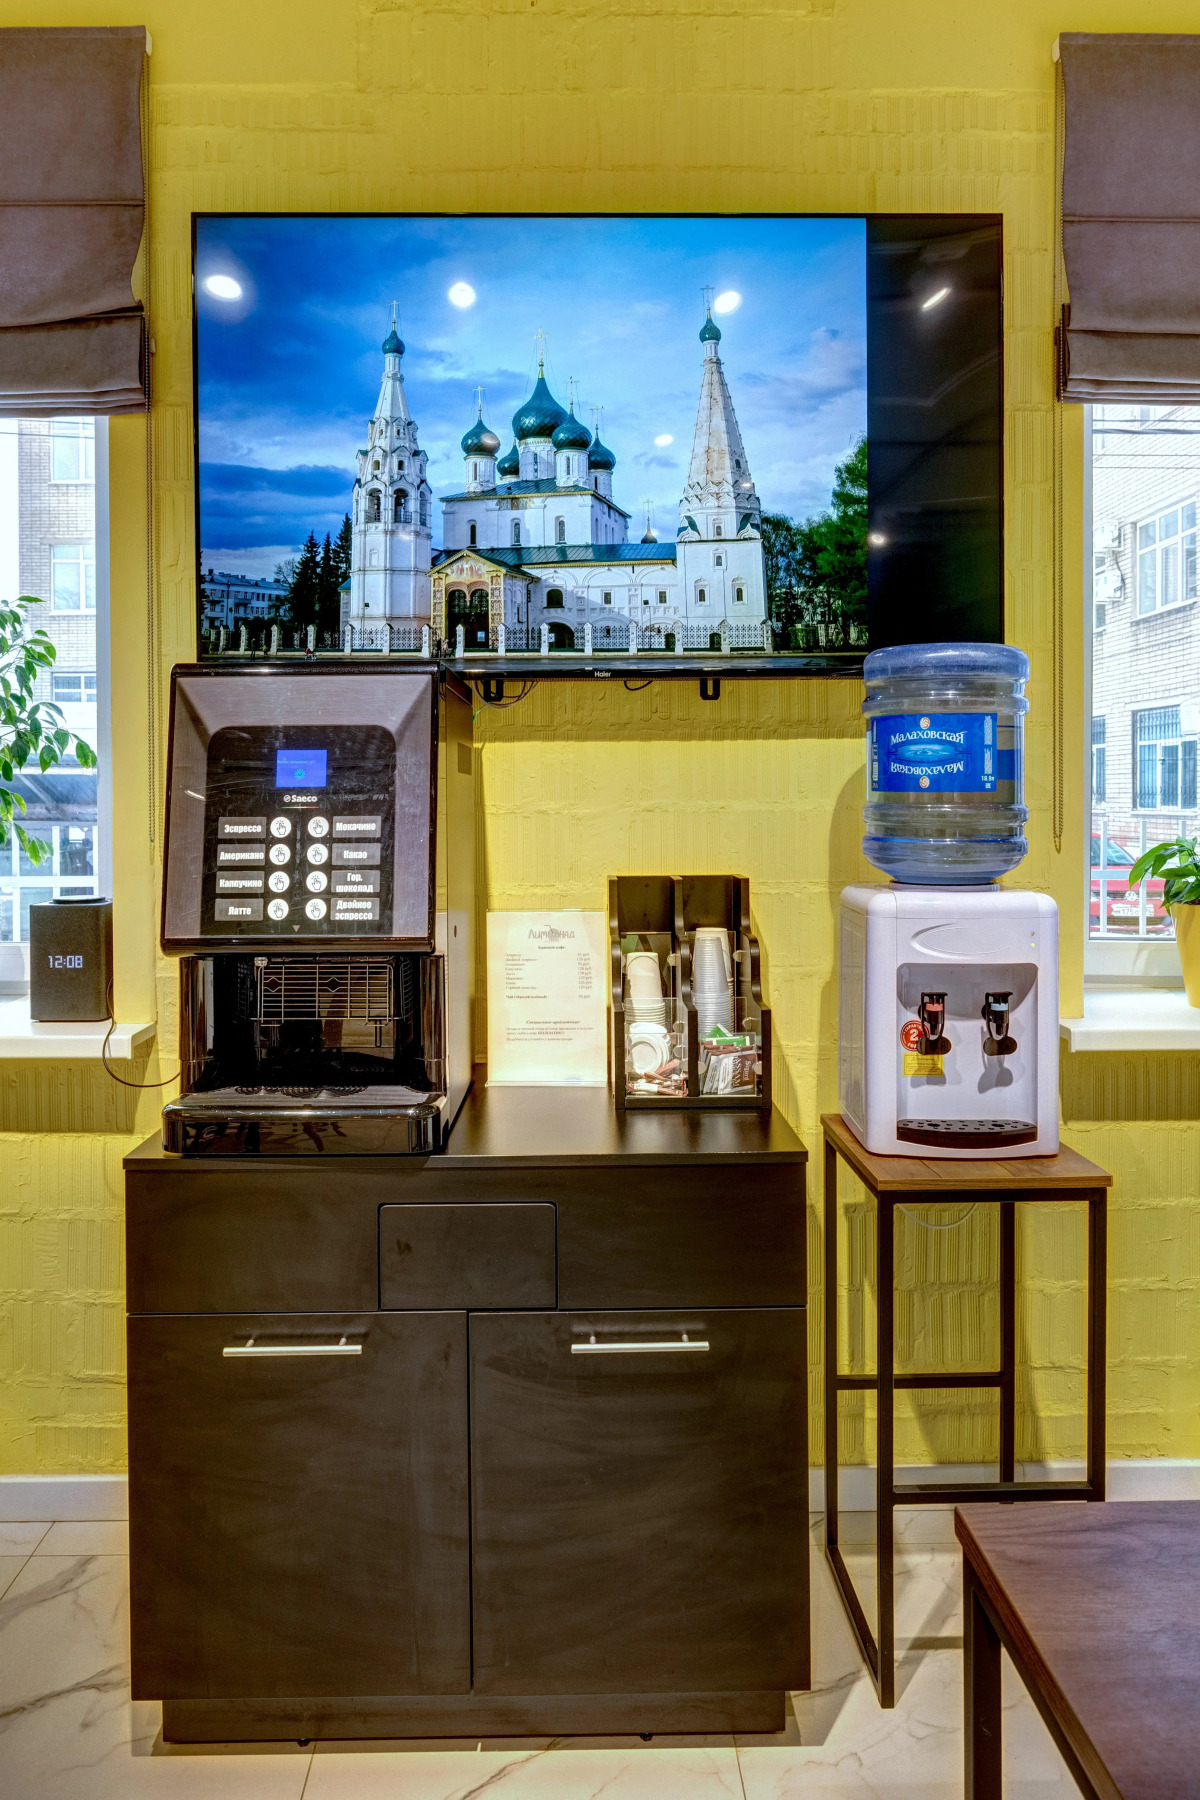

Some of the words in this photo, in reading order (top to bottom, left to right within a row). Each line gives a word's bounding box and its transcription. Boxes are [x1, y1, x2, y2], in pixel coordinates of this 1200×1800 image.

[890, 730, 968, 746] Малаховская
[291, 794, 318, 803] Saeco
[224, 824, 262, 834] Эспрессо
[335, 822, 376, 831] Мокачино
[219, 851, 265, 861] Американо
[343, 850, 368, 859] Какао
[346, 872, 363, 882] Гор.
[219, 879, 263, 888] Каппучино
[335, 884, 374, 893] шоколад
[336, 900, 372, 910] Двойное
[227, 906, 252, 915] Латте
[335, 912, 373, 920] эспрессо
[47, 955, 83, 969] 12:08
[910, 1028, 918, 1041] 2
